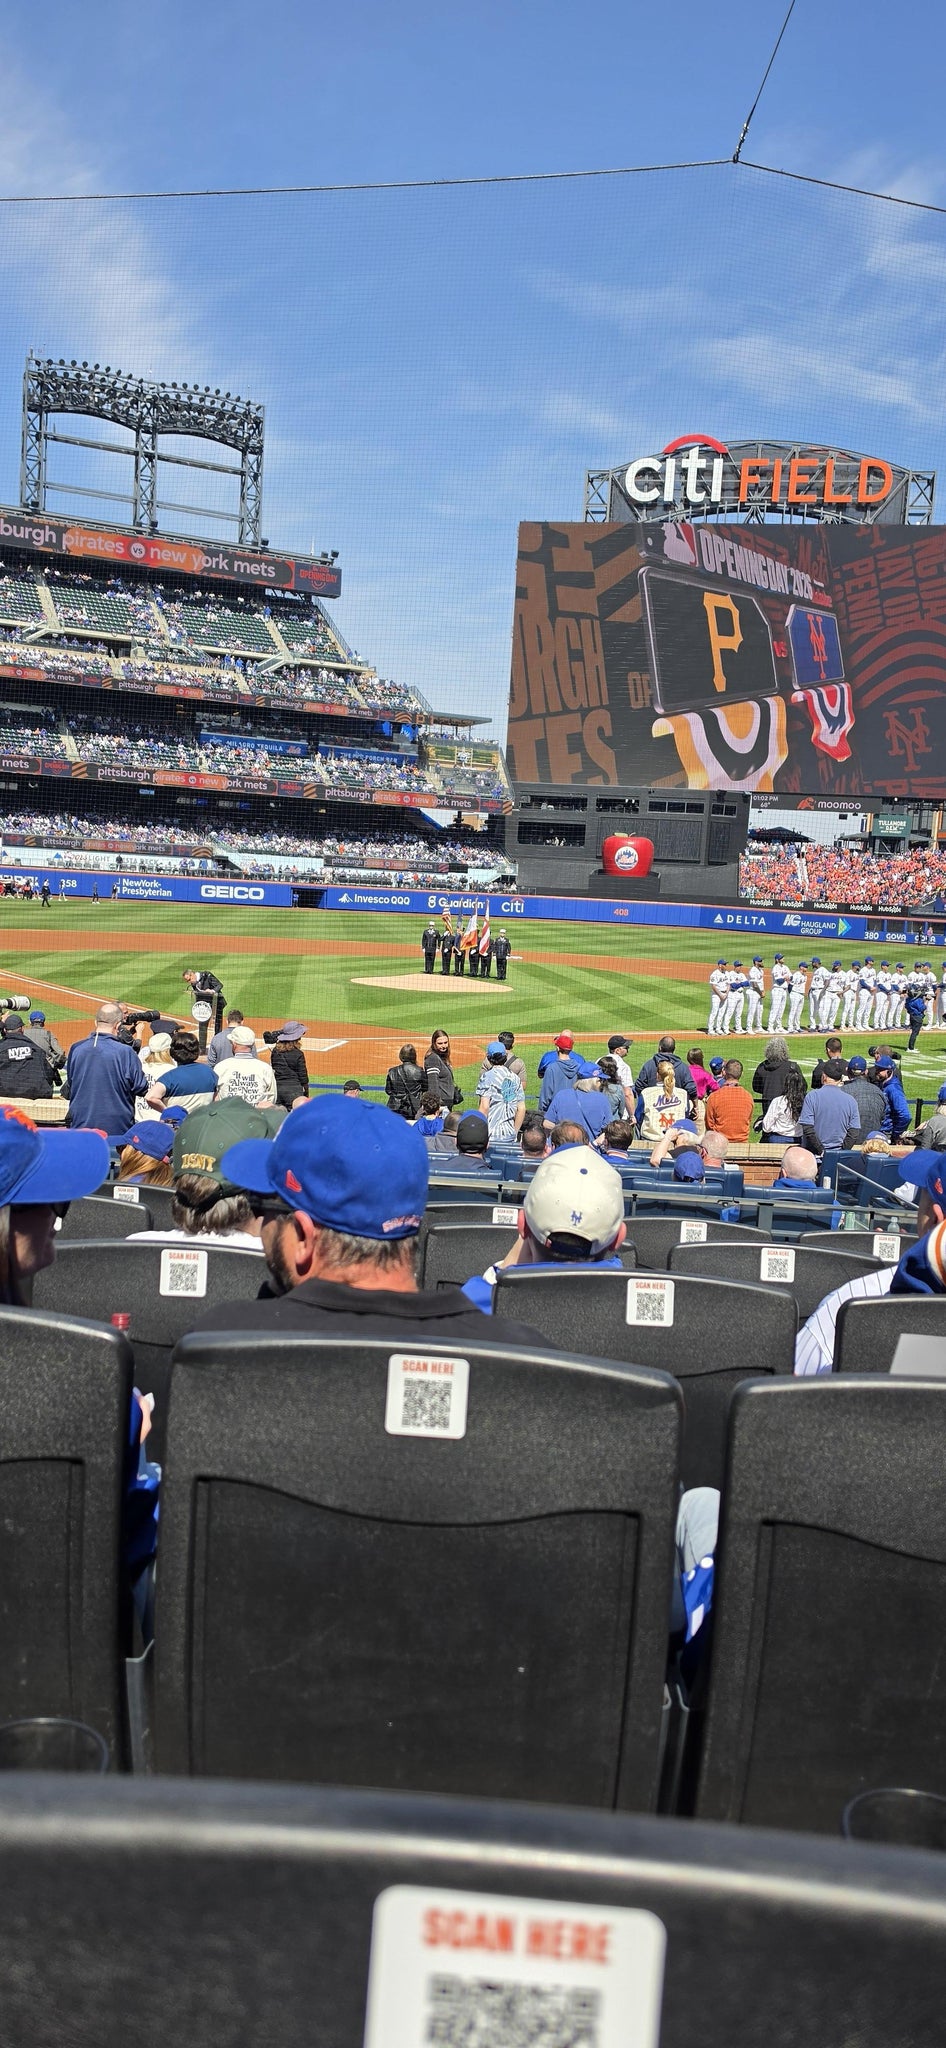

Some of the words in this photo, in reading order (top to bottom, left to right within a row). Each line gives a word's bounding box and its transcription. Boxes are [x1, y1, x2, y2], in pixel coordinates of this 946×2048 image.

[739, 457, 894, 503] FIELD
[0, 518, 57, 546] burgh
[62, 531, 125, 554] pirates
[150, 547, 187, 563] new
[192, 553, 229, 571] york
[233, 559, 276, 578] mets
[699, 529, 769, 589] OPENING
[118, 681, 154, 692] pittsburgh
[270, 699, 302, 710] pittsburgh
[257, 743, 283, 751] TEQUILA
[2, 759, 30, 769] mets
[97, 766, 150, 781] pittsburgh
[153, 772, 185, 784] pirates
[200, 777, 219, 786] new
[222, 778, 241, 790] york
[244, 781, 268, 791] mets
[325, 788, 371, 801] pittsburgh
[372, 792, 401, 802] pirates
[432, 797, 449, 808] york
[451, 799, 472, 809] mets
[817, 801, 861, 810] moomoo
[42, 838, 81, 848] pittsburgh
[332, 858, 363, 868] pittsburgh
[122, 878, 161, 889] NewYork-
[122, 887, 172, 897] Presbyterian
[201, 884, 264, 900] GEICO
[354, 893, 390, 905] Invesco
[391, 896, 410, 905] QQQ
[438, 897, 484, 909] Guardian
[750, 899, 773, 907] HubSpot
[780, 900, 804, 908] HubSpot
[814, 902, 837, 910] HubSpot
[850, 904, 873, 912] HubSpot
[878, 905, 902, 914] HubSpot
[613, 907, 629, 917] 408
[727, 914, 766, 926] DELTA
[801, 920, 836, 930] HAUGLAND
[864, 931, 879, 940] 380
[8, 1046, 31, 1059] NYPD
[232, 1071, 241, 1079] It
[230, 1079, 258, 1088] Always
[238, 1086, 259, 1094] New
[168, 1252, 184, 1260] SCAN
[402, 1359, 428, 1372] SCAN
[430, 1361, 455, 1376] HERE
[423, 1907, 514, 1953] SCAN
[525, 1917, 612, 1966] HERE
